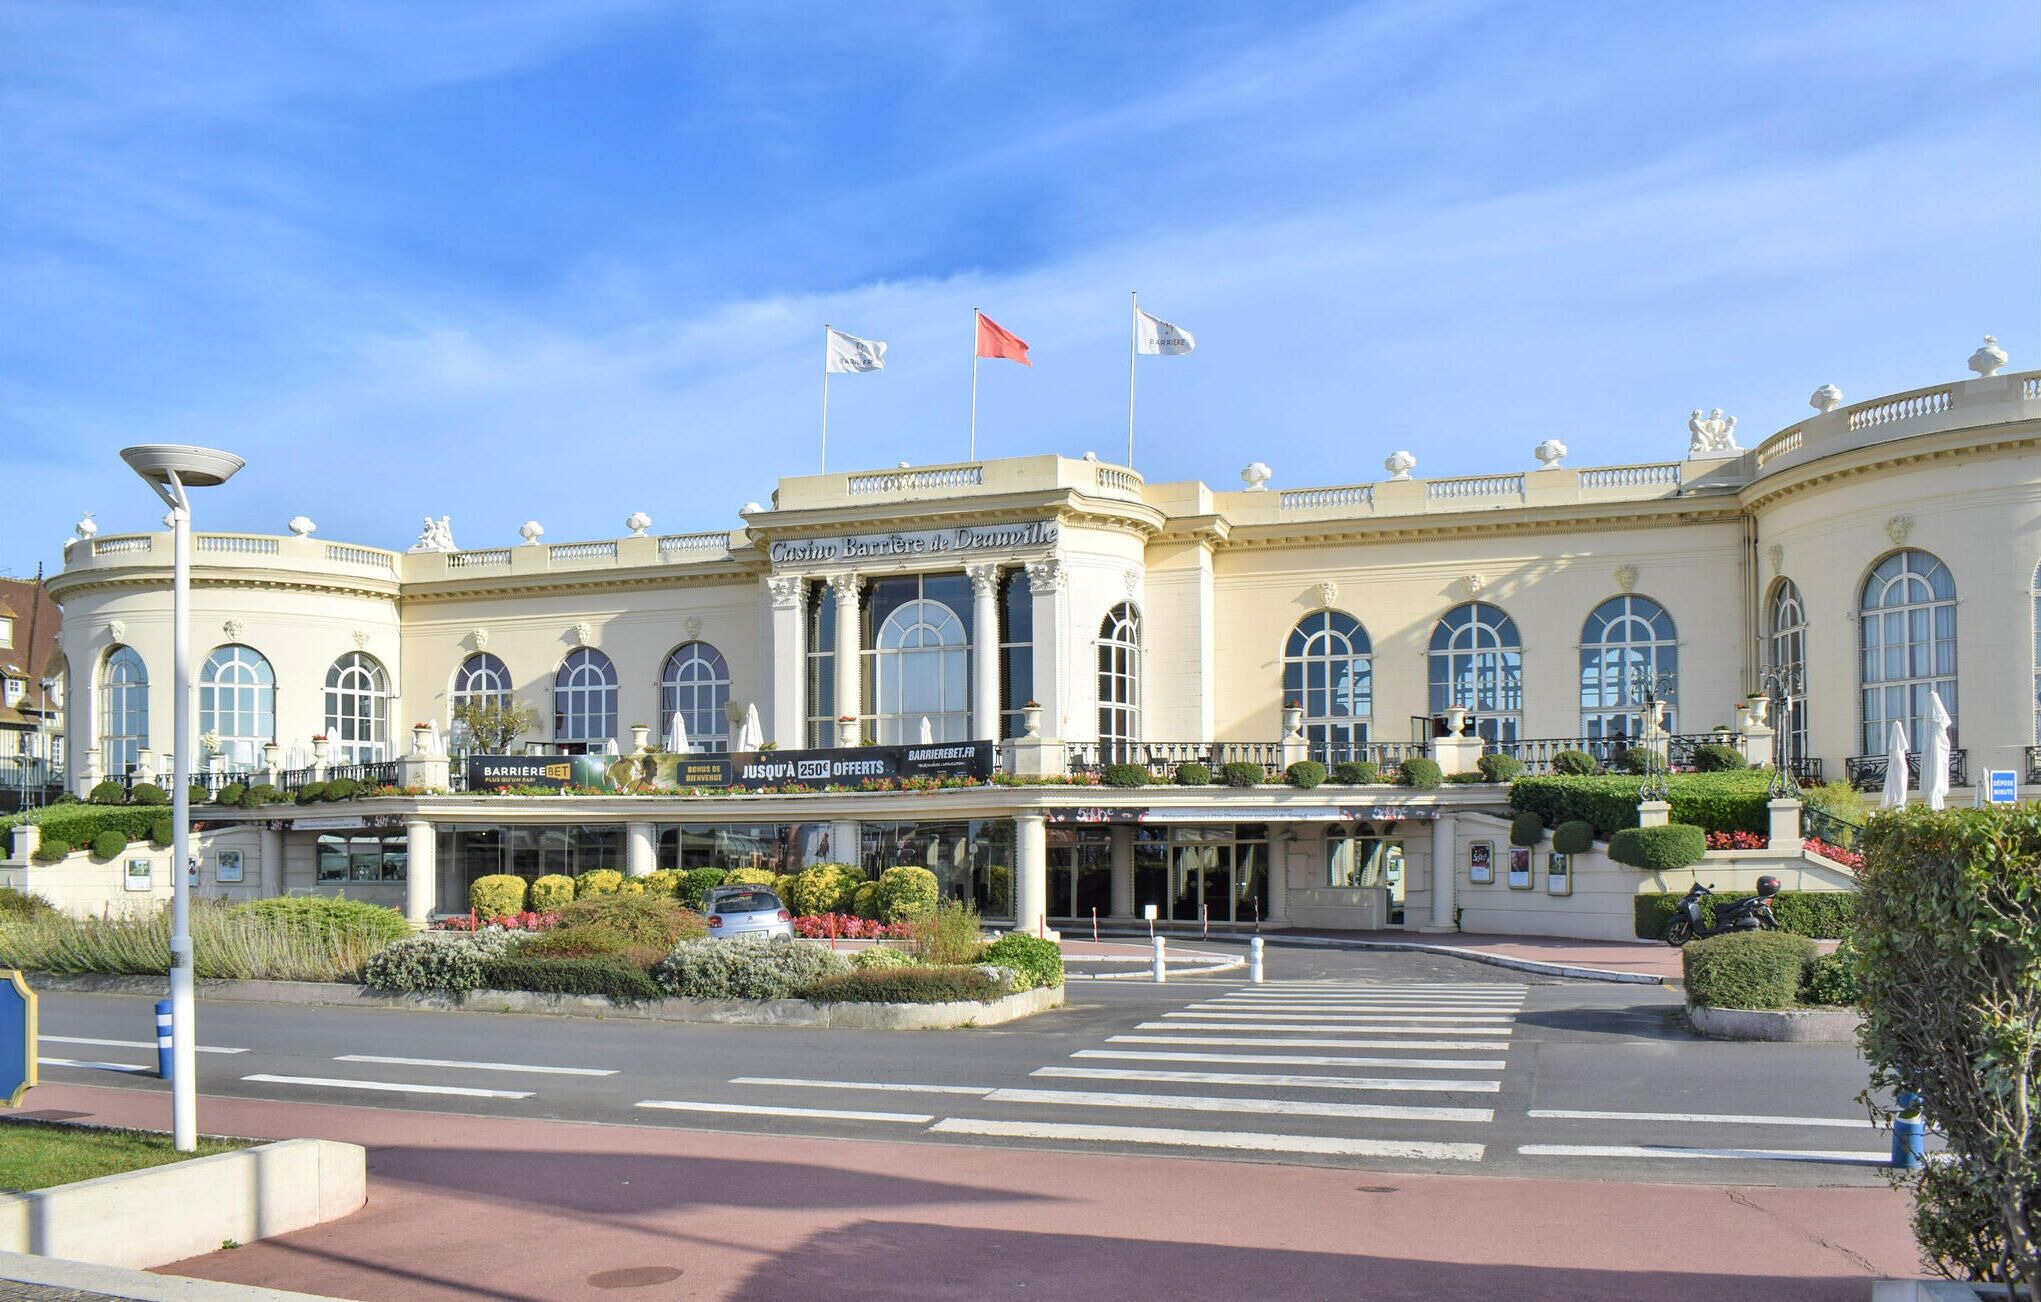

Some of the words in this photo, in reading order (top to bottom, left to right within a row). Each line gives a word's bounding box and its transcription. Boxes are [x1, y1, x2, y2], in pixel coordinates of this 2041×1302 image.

[770, 541, 836, 563] Casino
[842, 536, 923, 558] Barrière
[929, 535, 949, 552] de
[953, 520, 1059, 549] Deauville
[908, 746, 976, 761] BARRIEREBET.FR
[687, 765, 711, 774] BONUS
[711, 765, 721, 773] DE
[742, 761, 796, 780] JUSQU'À
[800, 762, 830, 777] 250€
[833, 760, 885, 777] OFFERTS
[685, 774, 722, 782] BIENVENUE
